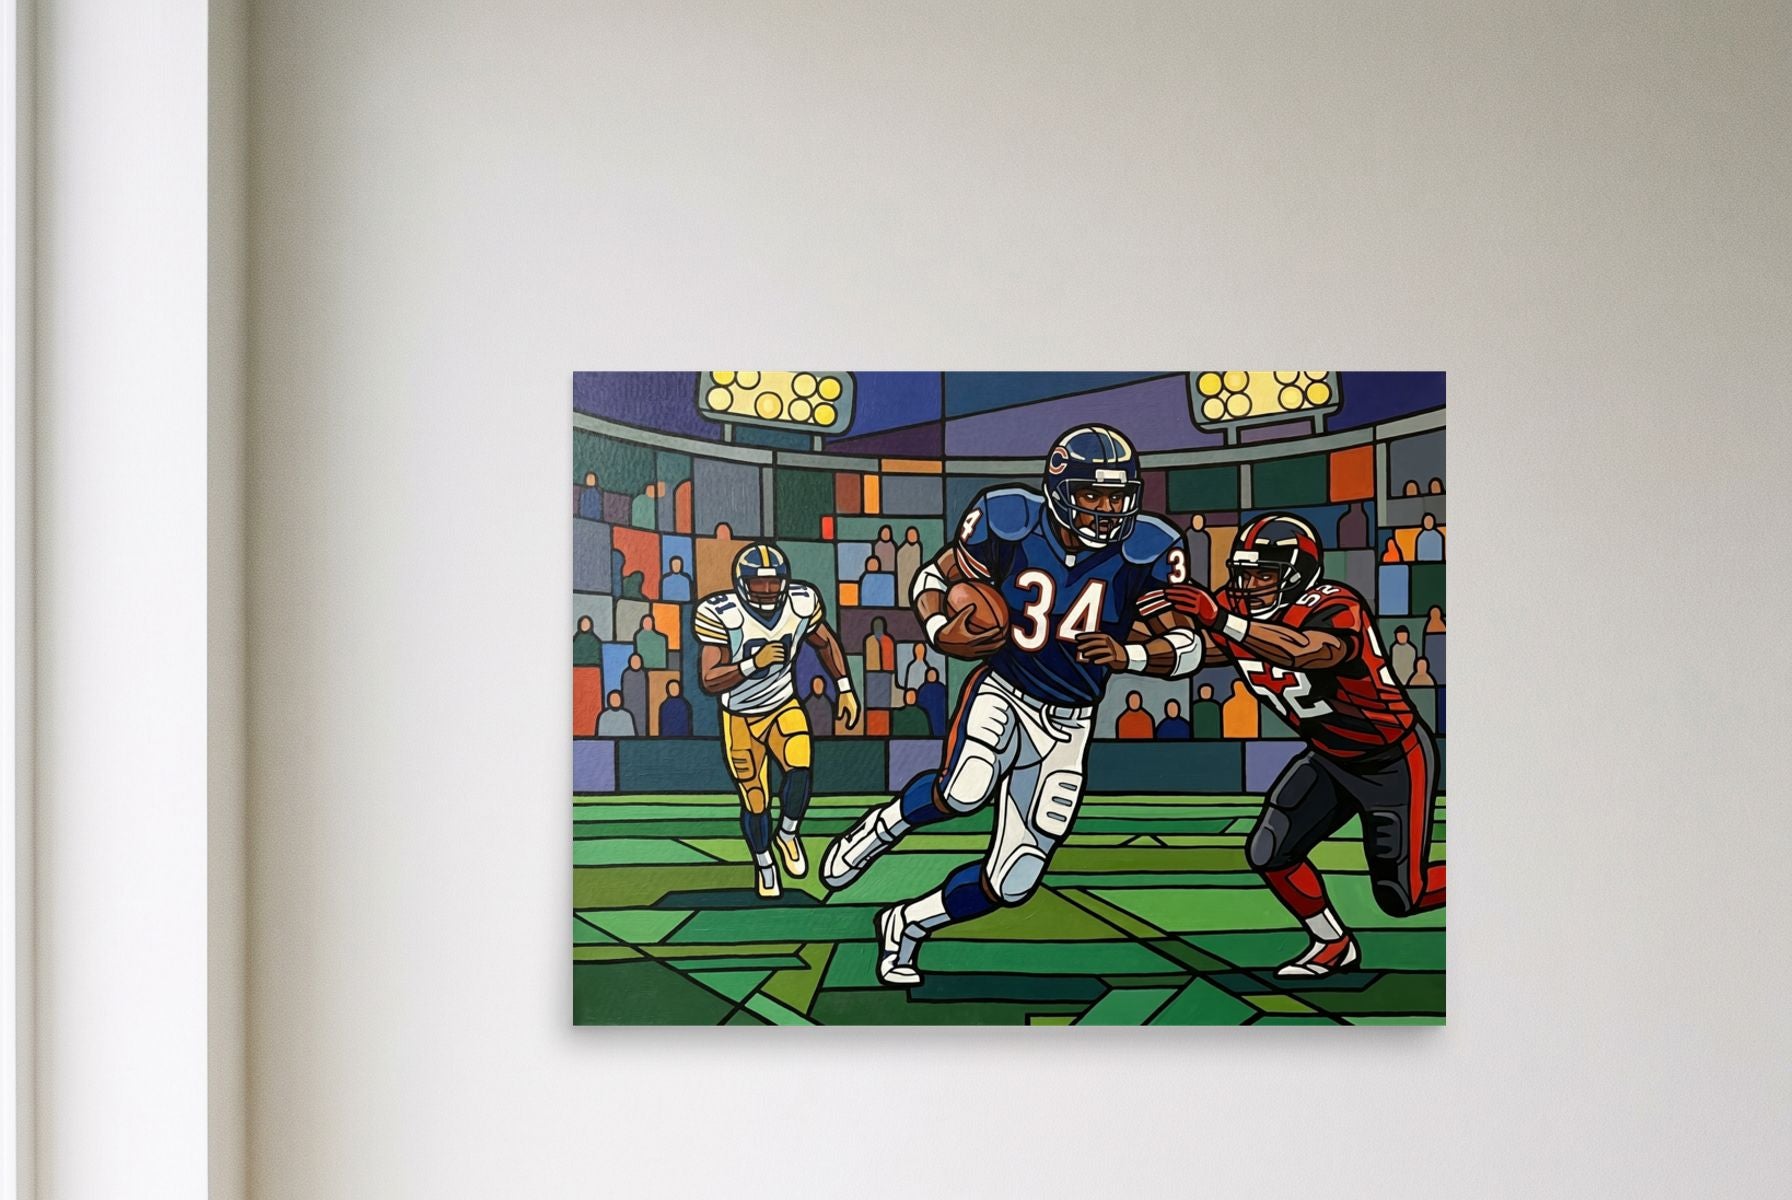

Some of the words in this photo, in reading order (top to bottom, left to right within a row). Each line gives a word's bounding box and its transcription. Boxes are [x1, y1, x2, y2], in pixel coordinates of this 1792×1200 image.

[1049, 446, 1069, 475] C
[1167, 548, 1186, 584] 3
[1010, 568, 1107, 662] 34
